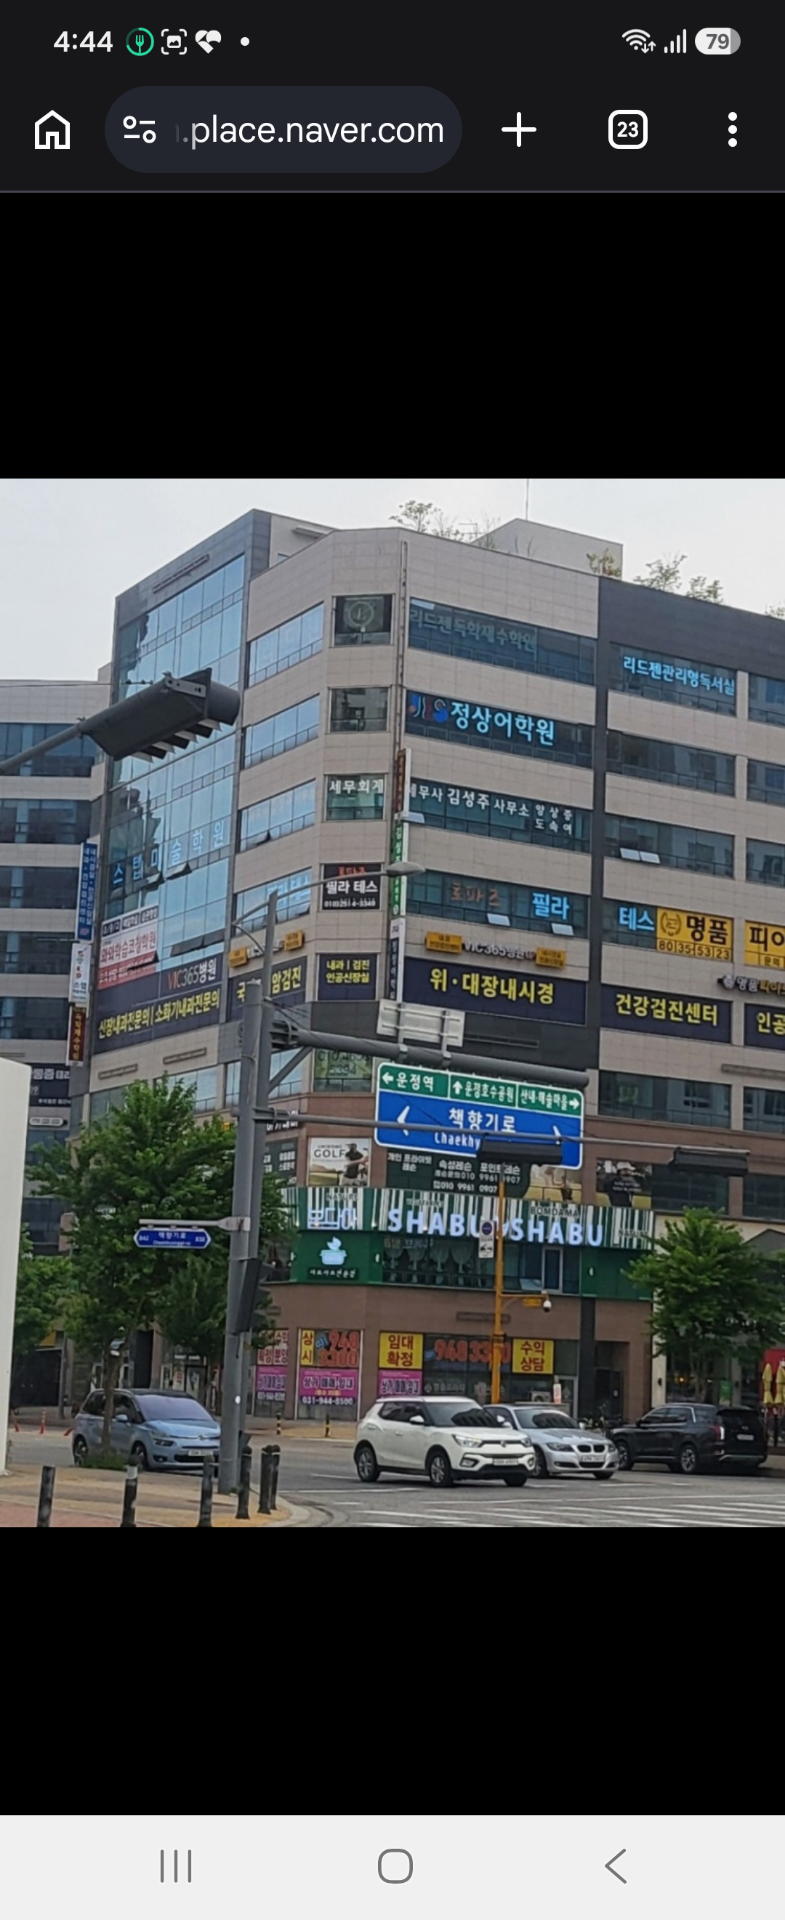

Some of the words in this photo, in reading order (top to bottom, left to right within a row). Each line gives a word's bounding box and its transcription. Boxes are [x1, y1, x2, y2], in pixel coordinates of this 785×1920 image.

[54, 31, 113, 52] 4:44
[706, 33, 729, 49] 79
[616, 121, 639, 138] 23
[451, 702, 554, 746] 정상어학원
[329, 779, 384, 794] 세무회계
[447, 788, 490, 810] 김성주
[494, 799, 529, 817] 사무소
[326, 880, 350, 895] 필라
[353, 880, 378, 894] 테스
[532, 892, 570, 920] 필라
[619, 907, 655, 931] 테스
[686, 915, 728, 945] 명품
[168, 958, 217, 990] VIC365병원
[326, 959, 345, 970] 내과
[353, 959, 370, 970] 검진
[326, 972, 370, 983] 인공신장실
[430, 969, 554, 1005] 위·대장내시경
[98, 1006, 150, 1039] 신장내과전문의
[154, 988, 220, 1022] 소화기내과전문의
[616, 994, 718, 1027] 건강검진센터
[396, 1072, 434, 1092] 운정역
[464, 1081, 514, 1103] 운정호수공원
[449, 1107, 516, 1133] 책향기로
[314, 1149, 345, 1158] GOLF
[531, 1206, 579, 1218] BOMDAMA
[388, 1209, 480, 1238] SHABU
[511, 1217, 603, 1247] SHABU
[388, 1334, 414, 1350] 임대
[520, 1340, 545, 1355] 수익
[387, 1351, 413, 1367] 확정
[520, 1359, 545, 1372] 상담
